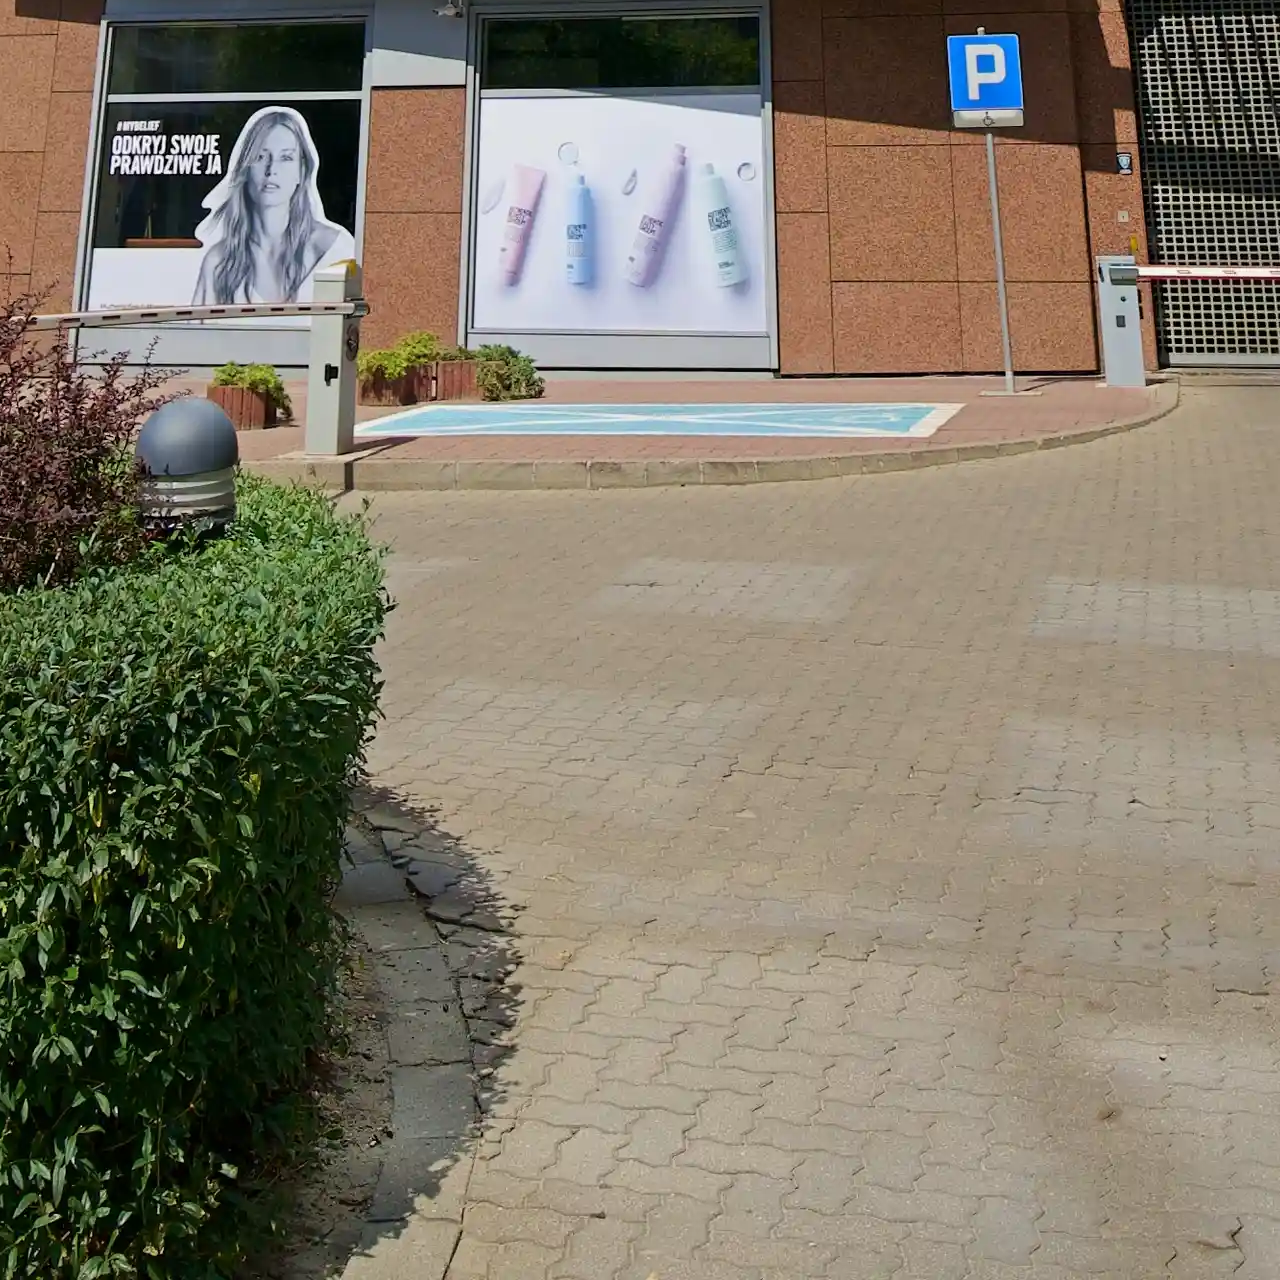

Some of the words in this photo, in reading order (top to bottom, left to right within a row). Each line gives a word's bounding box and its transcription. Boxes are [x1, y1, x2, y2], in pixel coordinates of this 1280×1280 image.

[965, 44, 1007, 101] P
[112, 135, 167, 154] ODKRYJ
[170, 134, 220, 155] SWOJE
[109, 154, 202, 175] PRAWDZIWE
[204, 154, 222, 175] JA
